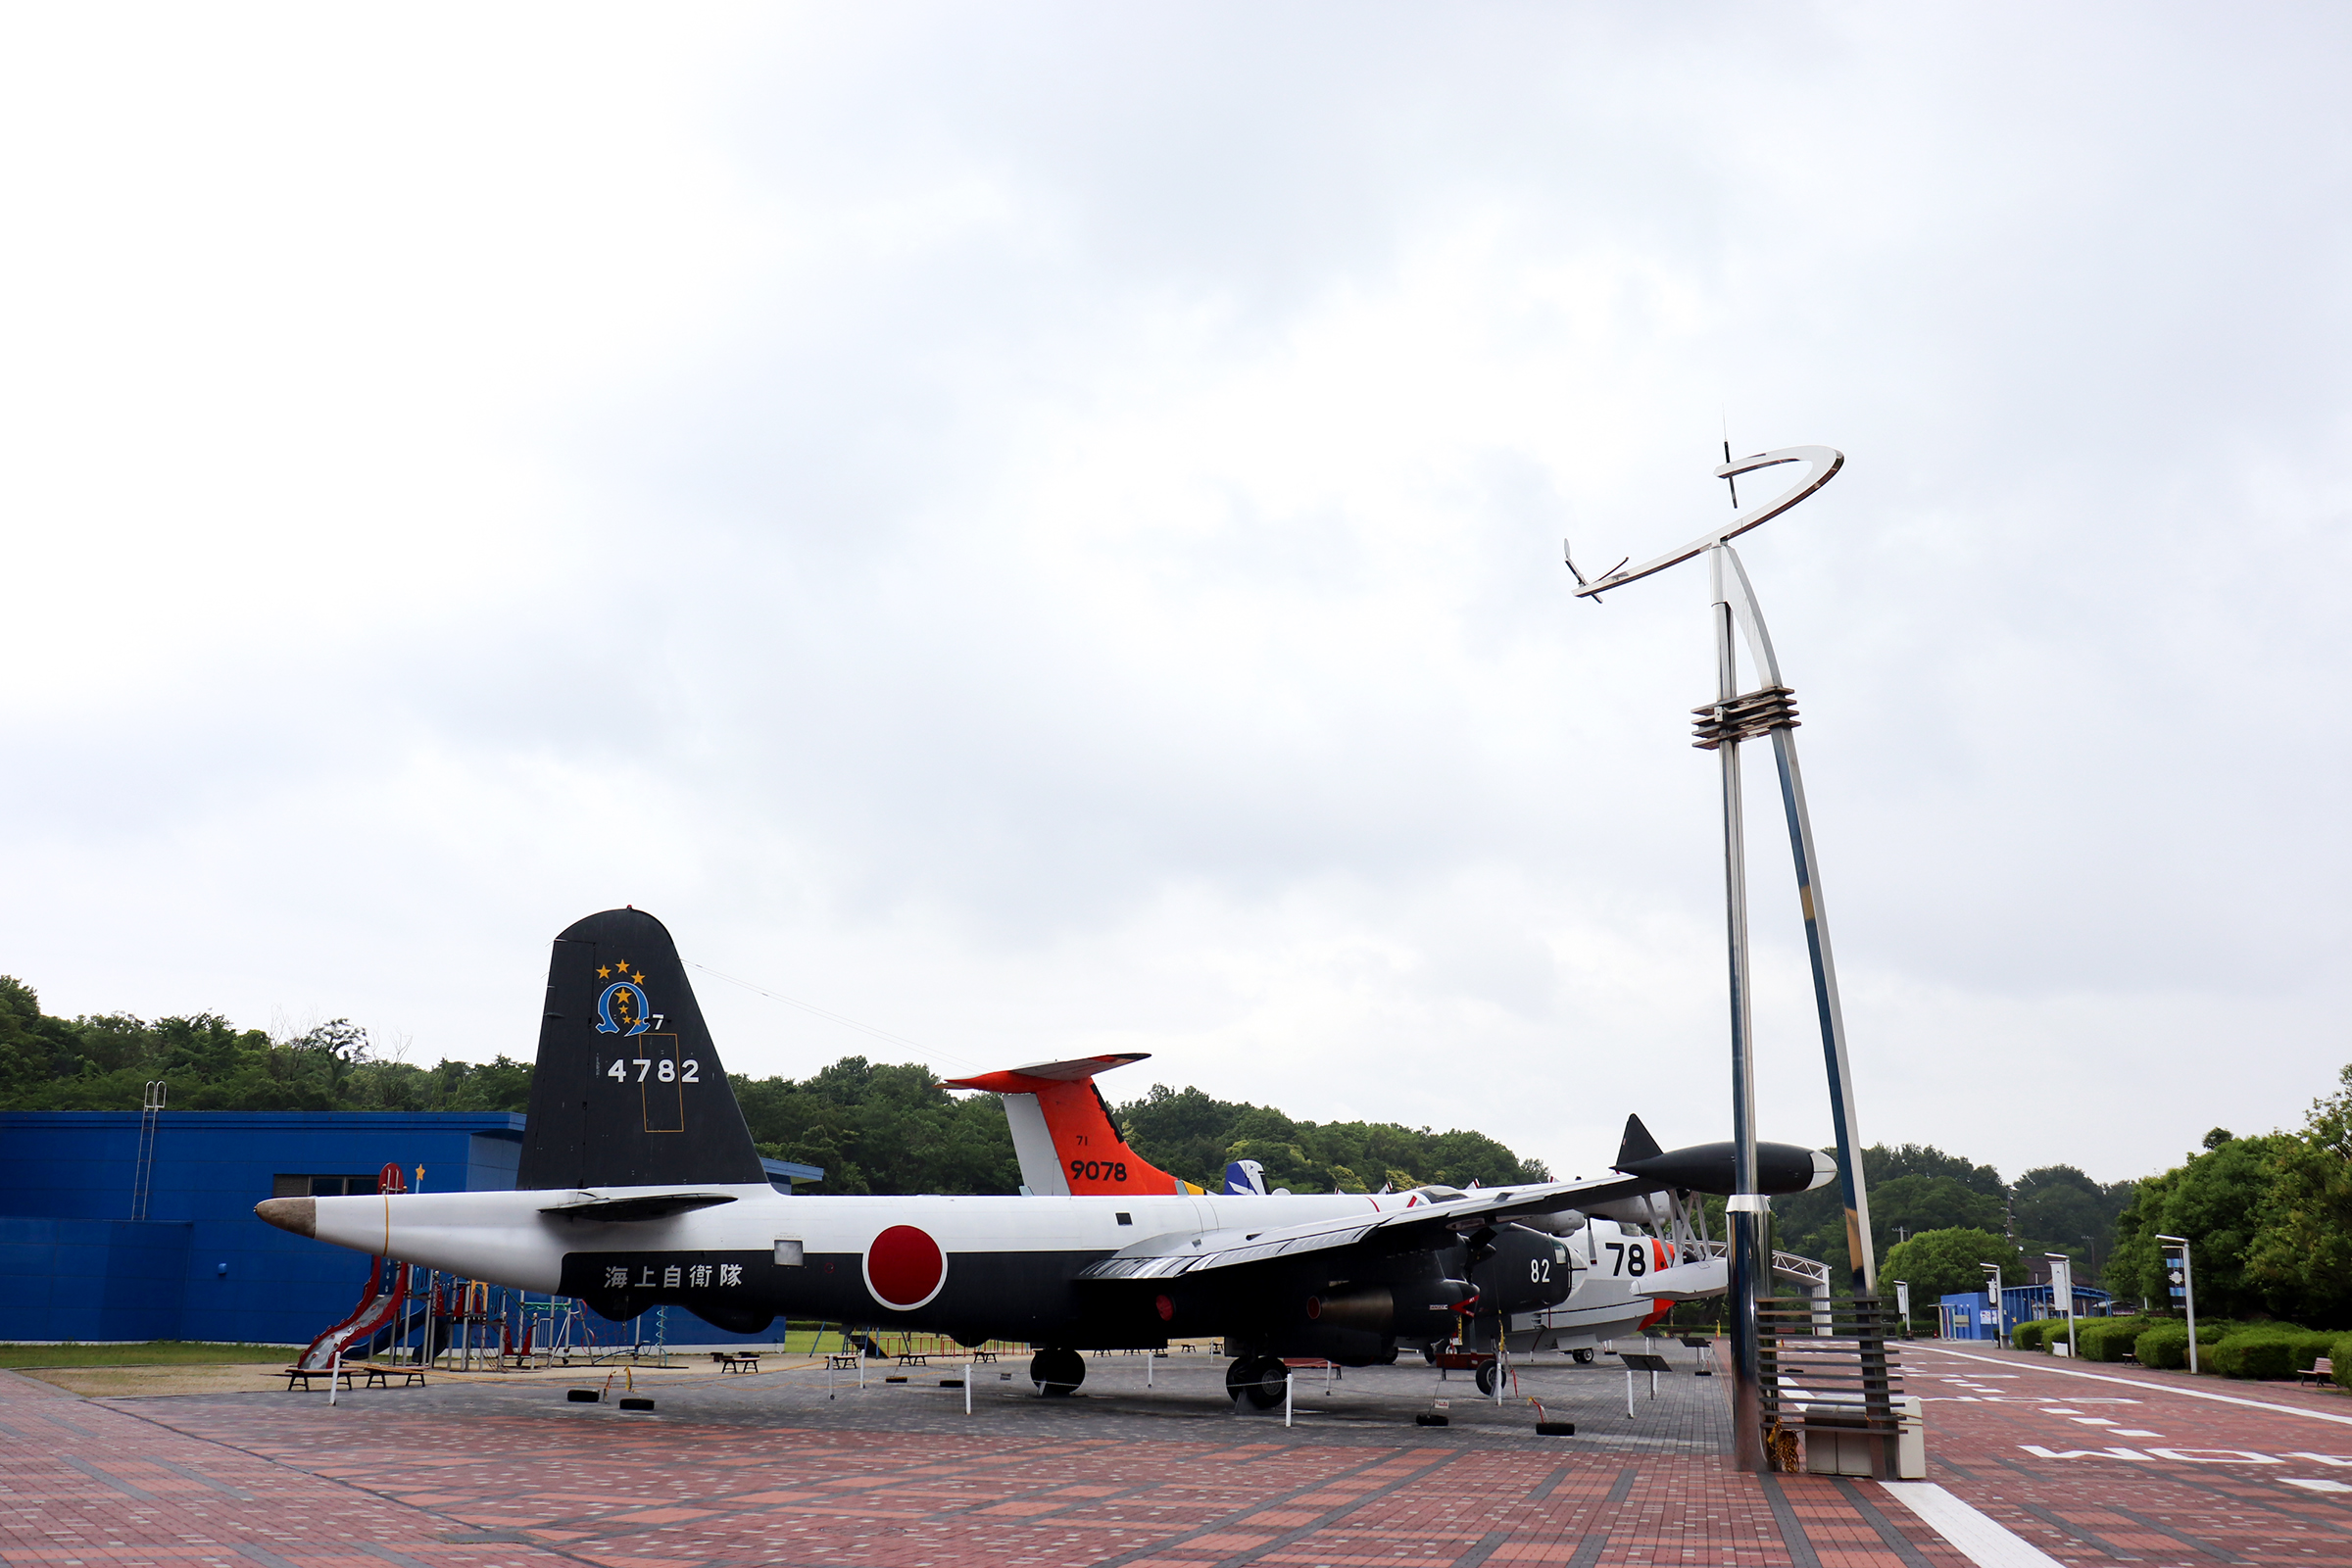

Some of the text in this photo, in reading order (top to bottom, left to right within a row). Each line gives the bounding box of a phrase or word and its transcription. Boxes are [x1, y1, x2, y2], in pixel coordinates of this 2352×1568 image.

[652, 1013, 664, 1030] 7
[608, 1058, 700, 1083] 4782
[1076, 1135, 1088, 1146] 71
[1069, 1159, 1128, 1183] 9078
[1530, 1258, 1550, 1284] 82
[1604, 1242, 1646, 1278] 78
[604, 1263, 743, 1289] 海上自衛隊
